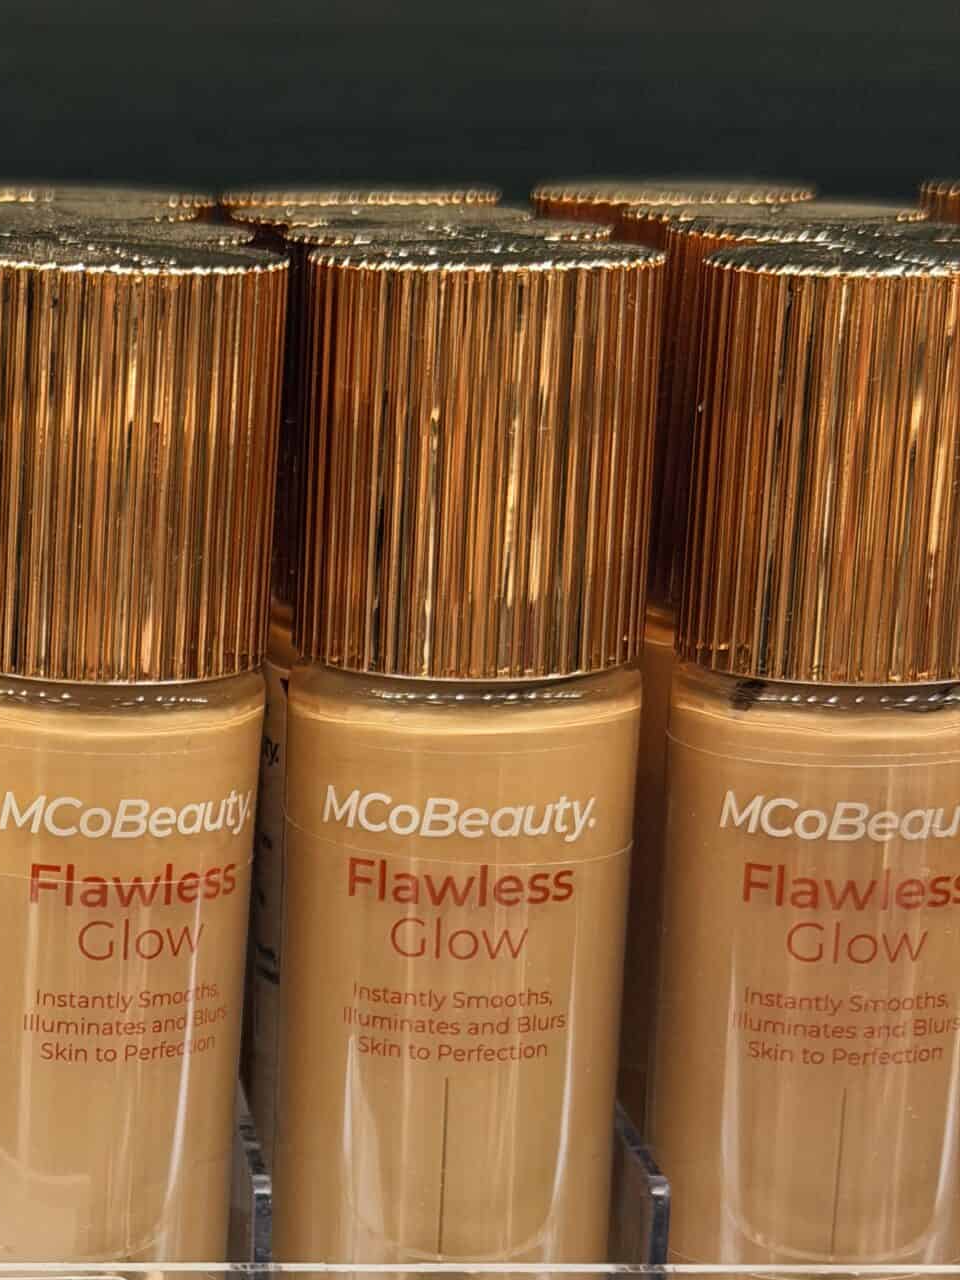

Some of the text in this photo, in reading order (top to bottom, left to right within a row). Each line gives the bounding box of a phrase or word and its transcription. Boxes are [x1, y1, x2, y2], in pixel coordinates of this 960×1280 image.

[322, 784, 597, 842] MCoBeauty.
[29, 863, 236, 909] Flawless
[347, 856, 575, 908] Flawless
[77, 917, 205, 962] Glow
[391, 915, 529, 961] Glow
[786, 921, 929, 965] Glow
[35, 988, 133, 1013] Instantly
[352, 982, 554, 1013] Instantly Smooths,
[744, 986, 844, 1017] Instantly
[23, 1012, 146, 1038] Illuminates
[342, 1007, 567, 1037] Illuminates and Blurs
[40, 1041, 88, 1064] Skin
[96, 1045, 118, 1063] to
[357, 1035, 549, 1063] Skin to Perfection
[747, 1040, 944, 1067] Skin to Perfection
